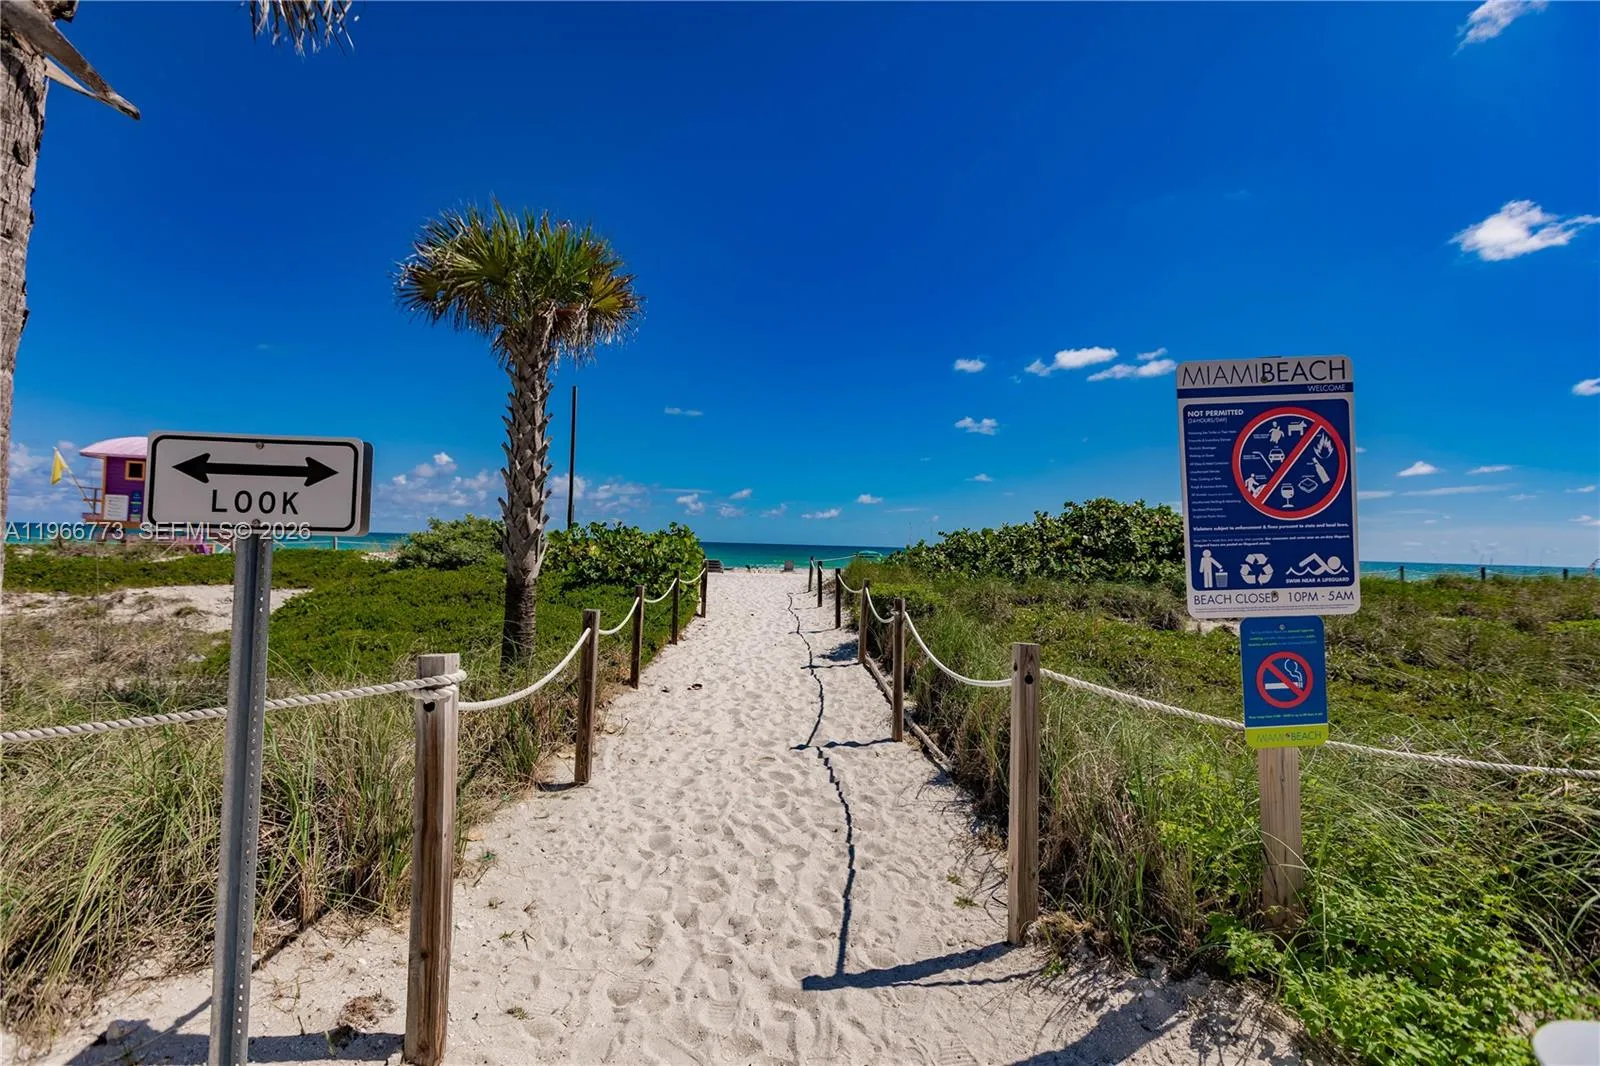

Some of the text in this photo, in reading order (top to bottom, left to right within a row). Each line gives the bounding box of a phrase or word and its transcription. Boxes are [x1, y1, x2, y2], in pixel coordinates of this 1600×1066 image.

[1307, 384, 1346, 393] WELCOME
[1187, 409, 1245, 418] NOT PERMITTED
[210, 489, 300, 516] LOOK
[1193, 593, 1232, 606] BEACH
[1235, 591, 1280, 605] CLOSED
[1287, 591, 1319, 602] 10PM
[1327, 589, 1355, 601] 5AM
[1290, 729, 1322, 742] BEACH
